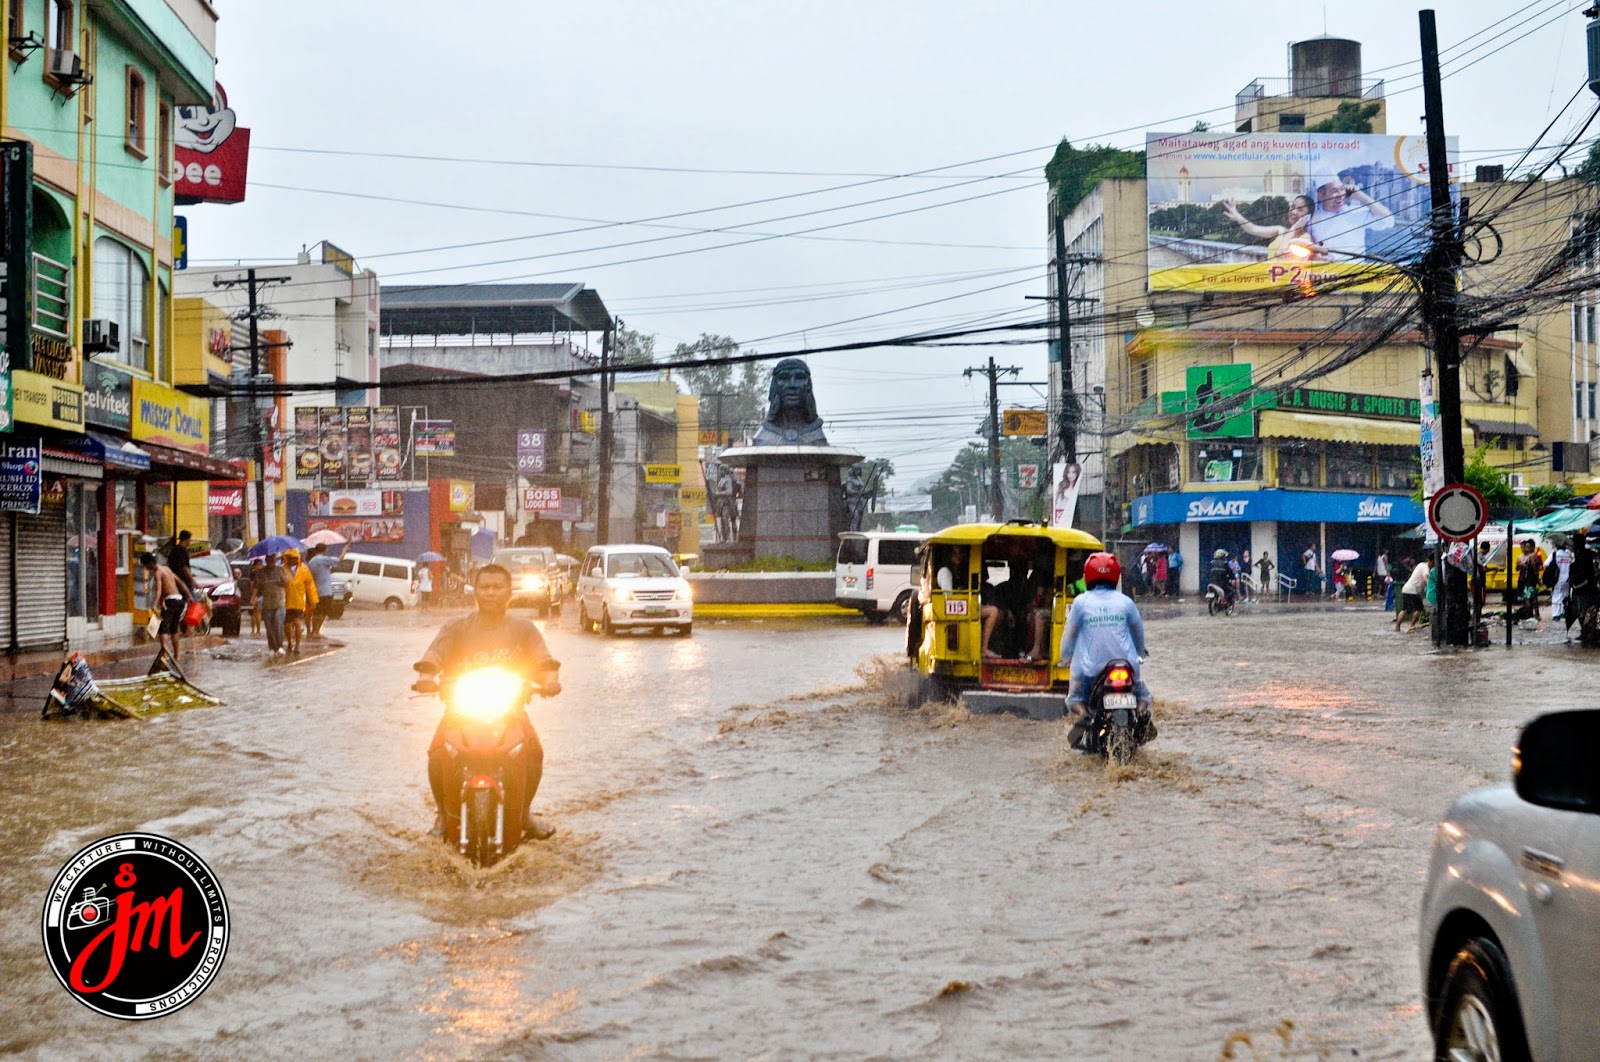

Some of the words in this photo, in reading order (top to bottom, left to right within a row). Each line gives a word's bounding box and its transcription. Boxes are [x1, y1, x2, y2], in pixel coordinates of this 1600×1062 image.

[1157, 138, 1220, 151] Maitatawag
[1222, 139, 1248, 151] agad
[1250, 141, 1269, 151] ang
[1272, 138, 1319, 149] kuwento
[1321, 139, 1360, 149] abroad!
[1308, 390, 1347, 411] MUSIC
[1350, 397, 1360, 412] &
[1364, 396, 1405, 416] SPORTS
[520, 433, 542, 447] 38
[518, 455, 543, 468] 695
[526, 489, 558, 500] BOSS
[524, 500, 548, 509] LODGE
[549, 500, 559, 509] INN
[1187, 500, 1249, 517] SMART
[1357, 501, 1393, 517] SMART
